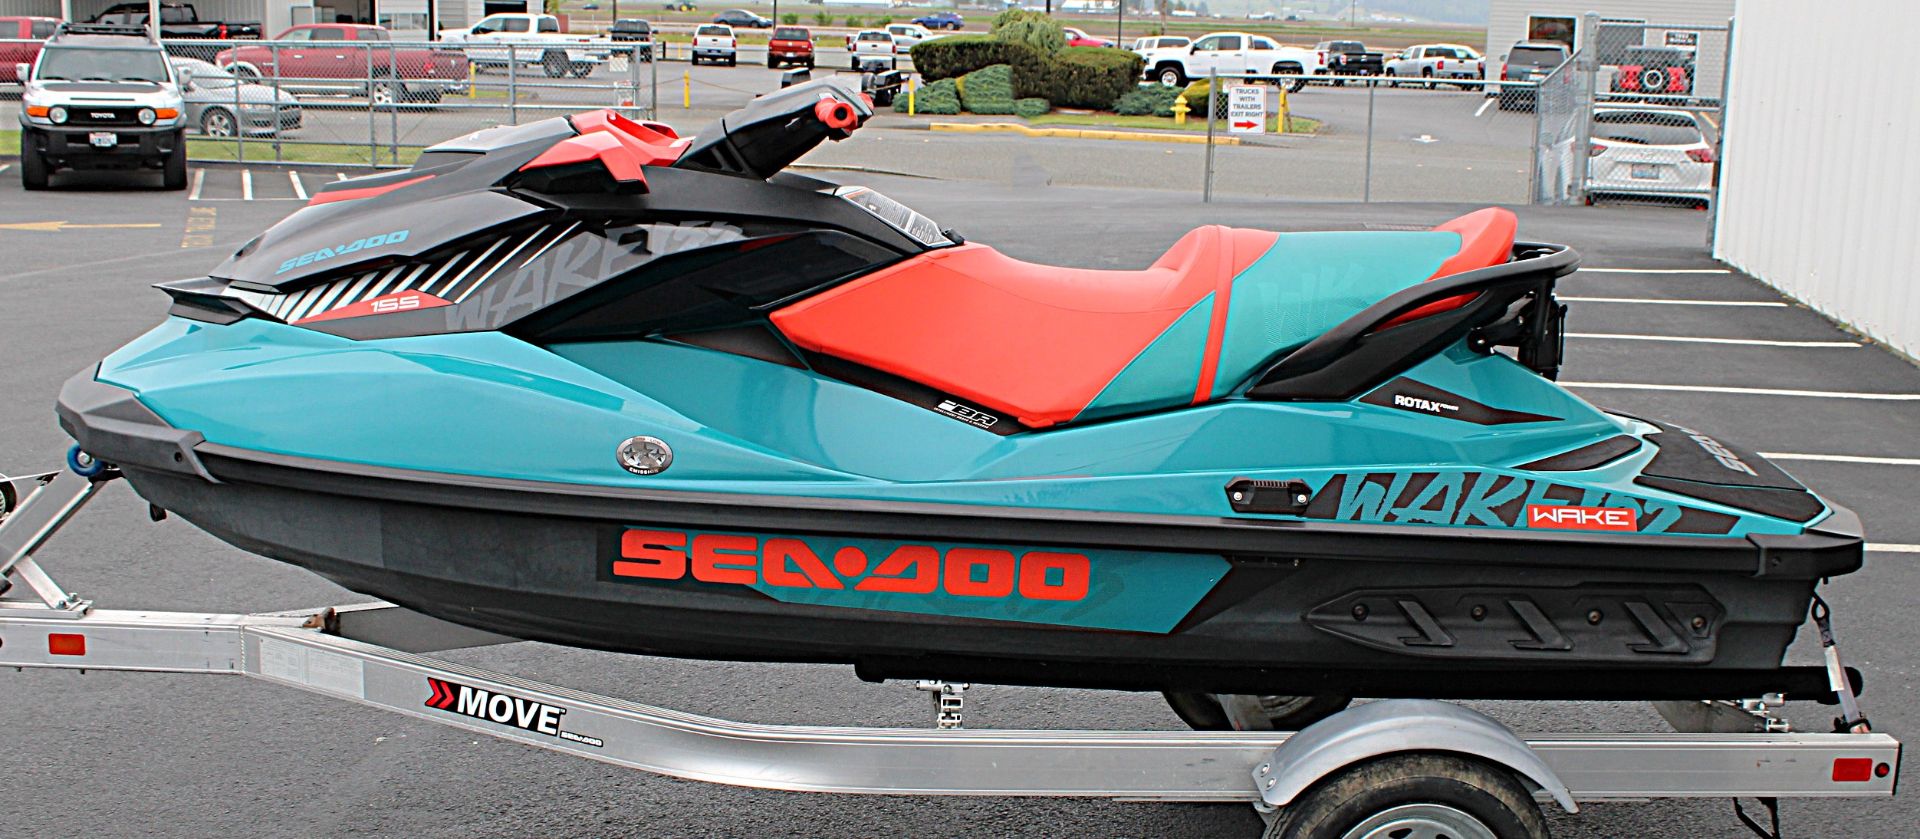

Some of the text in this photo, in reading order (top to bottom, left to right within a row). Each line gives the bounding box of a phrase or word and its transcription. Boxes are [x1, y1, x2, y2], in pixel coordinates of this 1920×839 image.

[370, 295, 420, 313] 155
[1394, 394, 1440, 413] ROTAX
[1533, 507, 1630, 526] WAKE
[457, 685, 561, 736] MOVE
